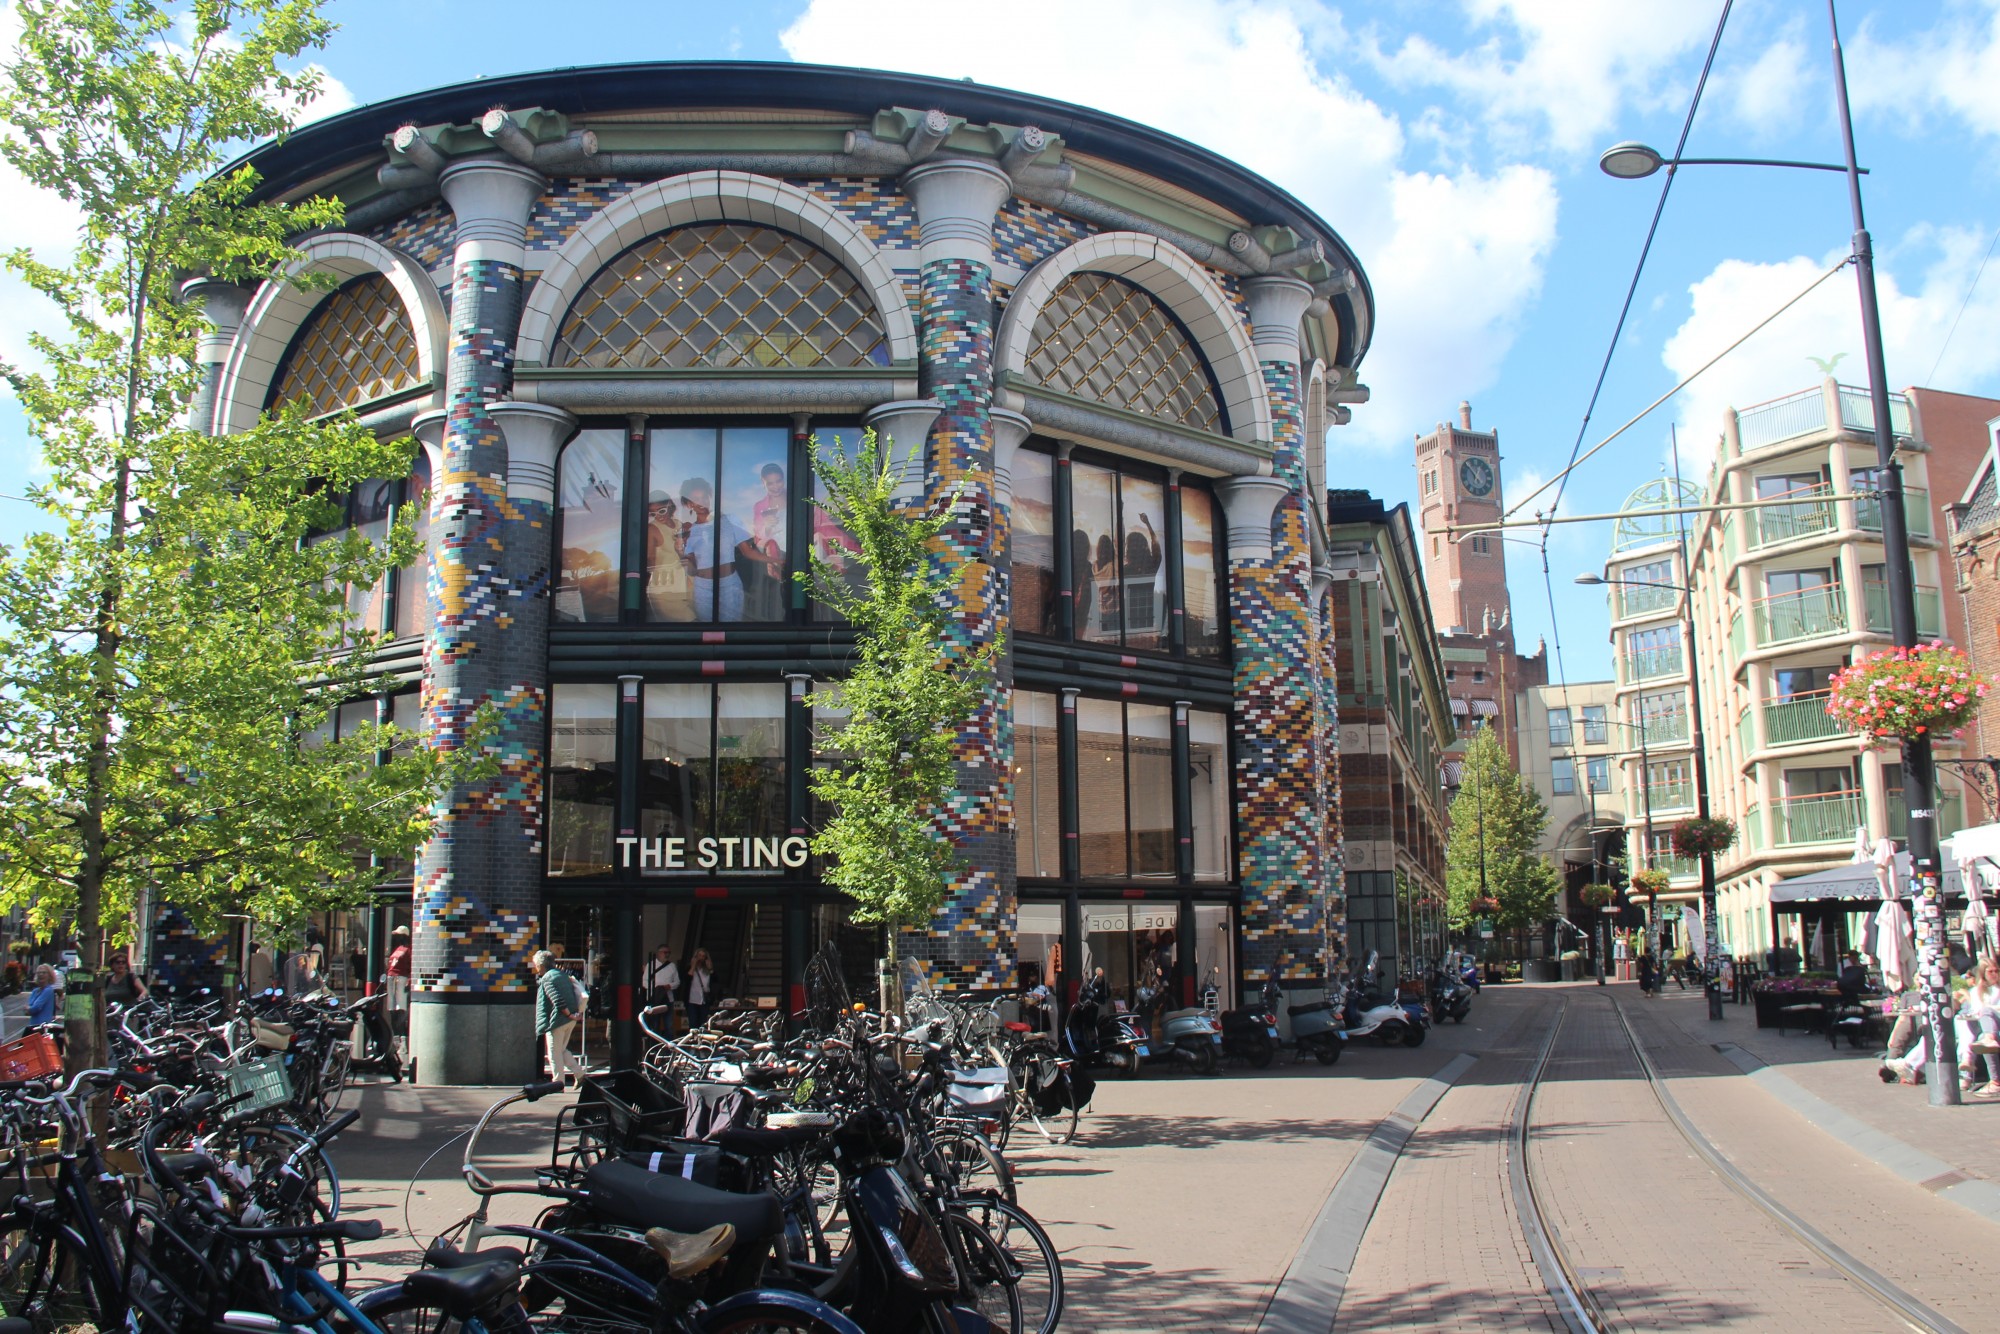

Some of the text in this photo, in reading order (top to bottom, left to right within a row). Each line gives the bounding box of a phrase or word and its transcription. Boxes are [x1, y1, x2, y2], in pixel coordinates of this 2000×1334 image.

[616, 836, 809, 868] THE STING
[1803, 883, 1838, 898] HOTEL
